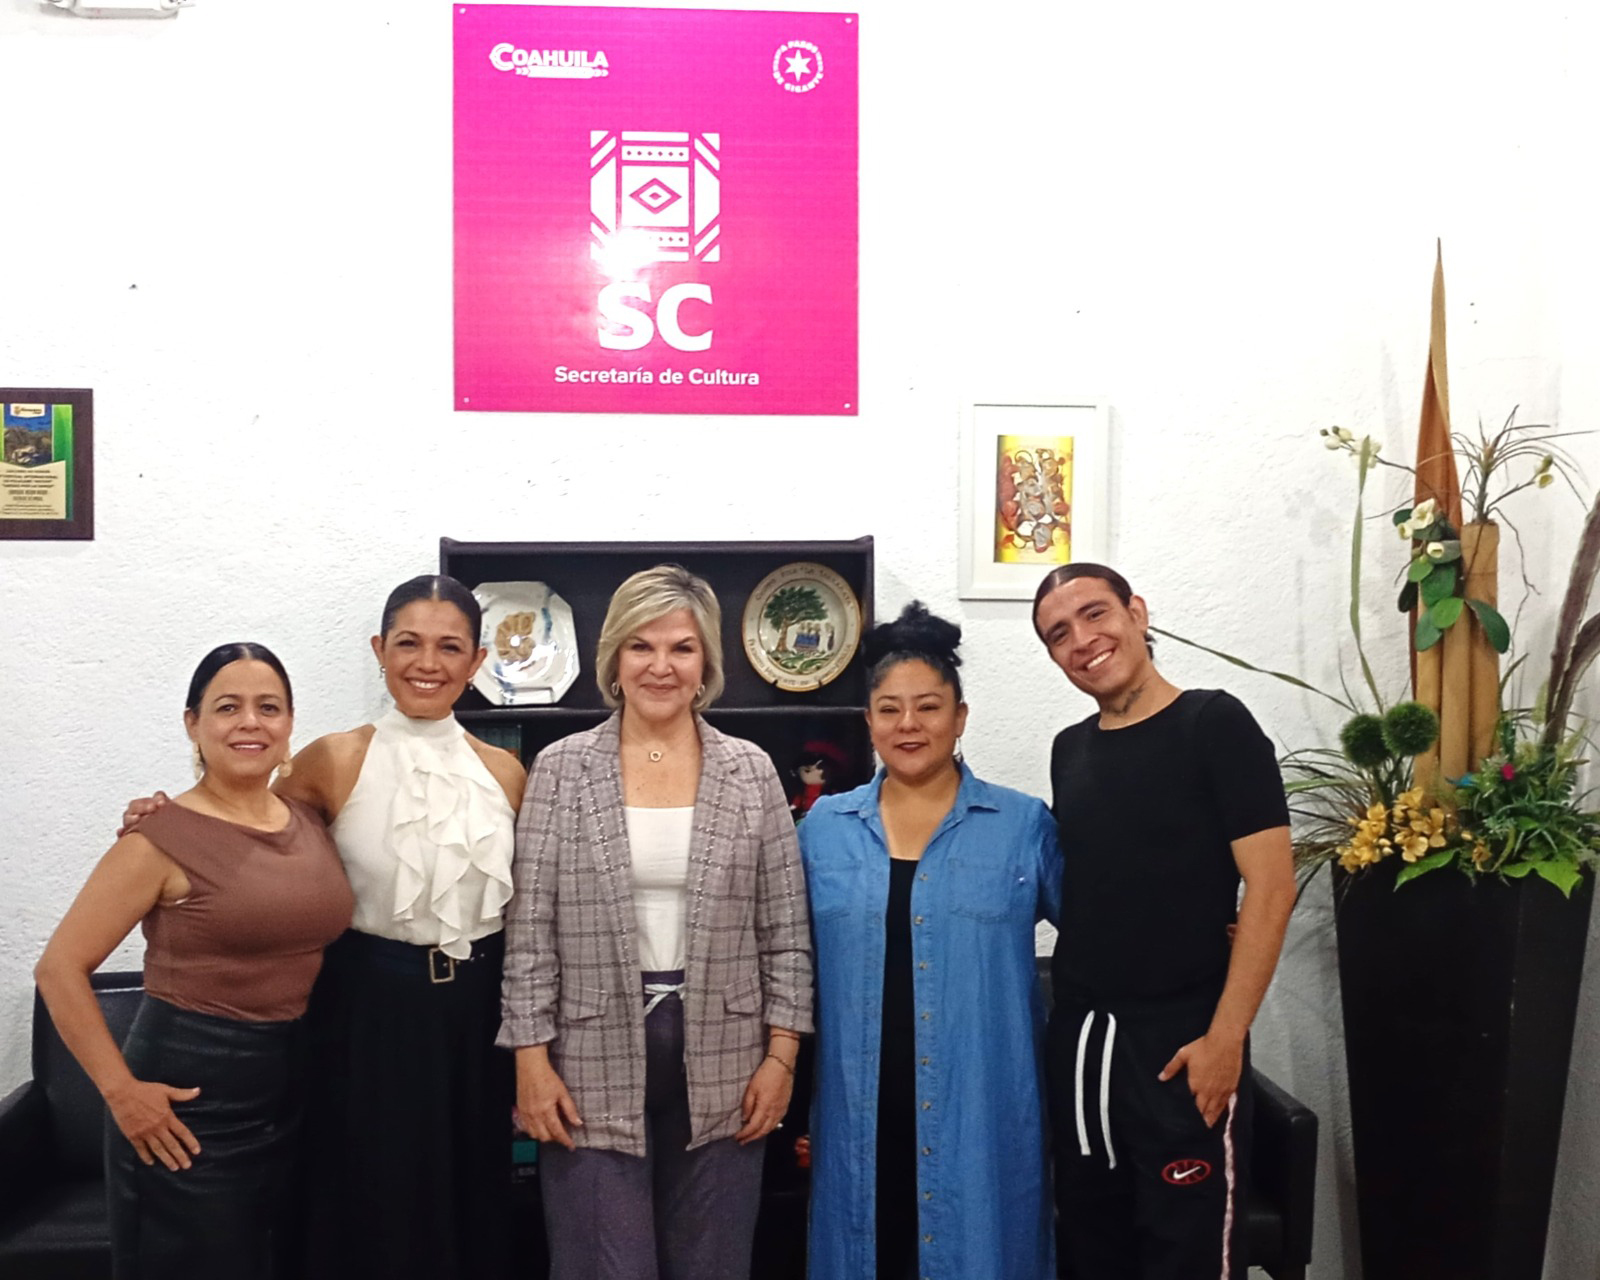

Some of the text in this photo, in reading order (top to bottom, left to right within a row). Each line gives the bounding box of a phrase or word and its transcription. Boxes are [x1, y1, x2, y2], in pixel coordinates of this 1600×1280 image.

[489, 42, 609, 71] COAHUILA
[597, 281, 713, 352] SC
[554, 366, 760, 386] Secretaría de Cultura
